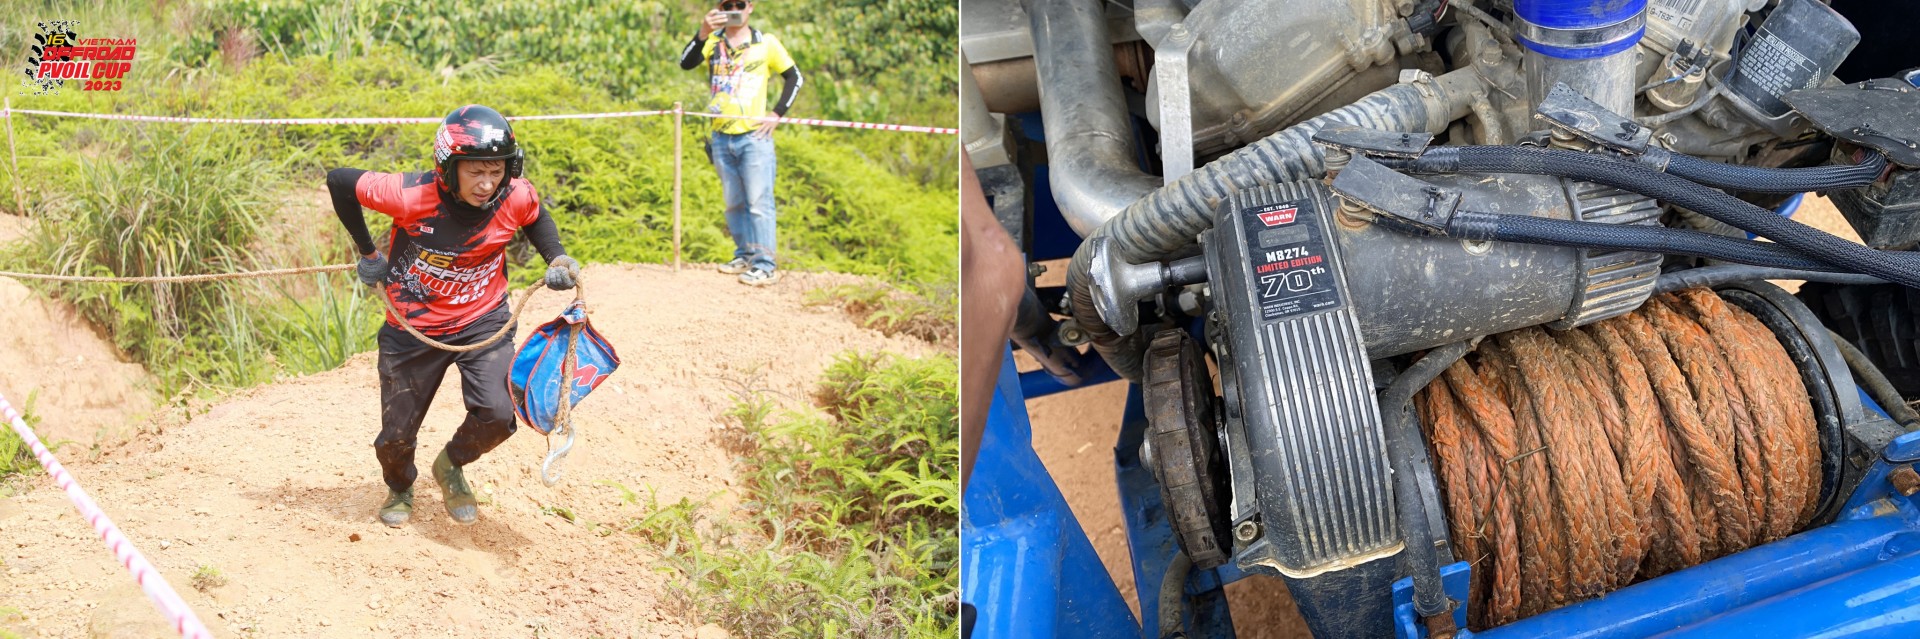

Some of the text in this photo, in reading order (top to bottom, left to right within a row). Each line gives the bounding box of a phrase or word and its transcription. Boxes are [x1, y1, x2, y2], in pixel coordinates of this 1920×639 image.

[1265, 212, 1292, 223] WARN
[418, 250, 453, 268] 16
[1266, 246, 1309, 263] M8274
[1256, 255, 1323, 274] LIMITED EDITION
